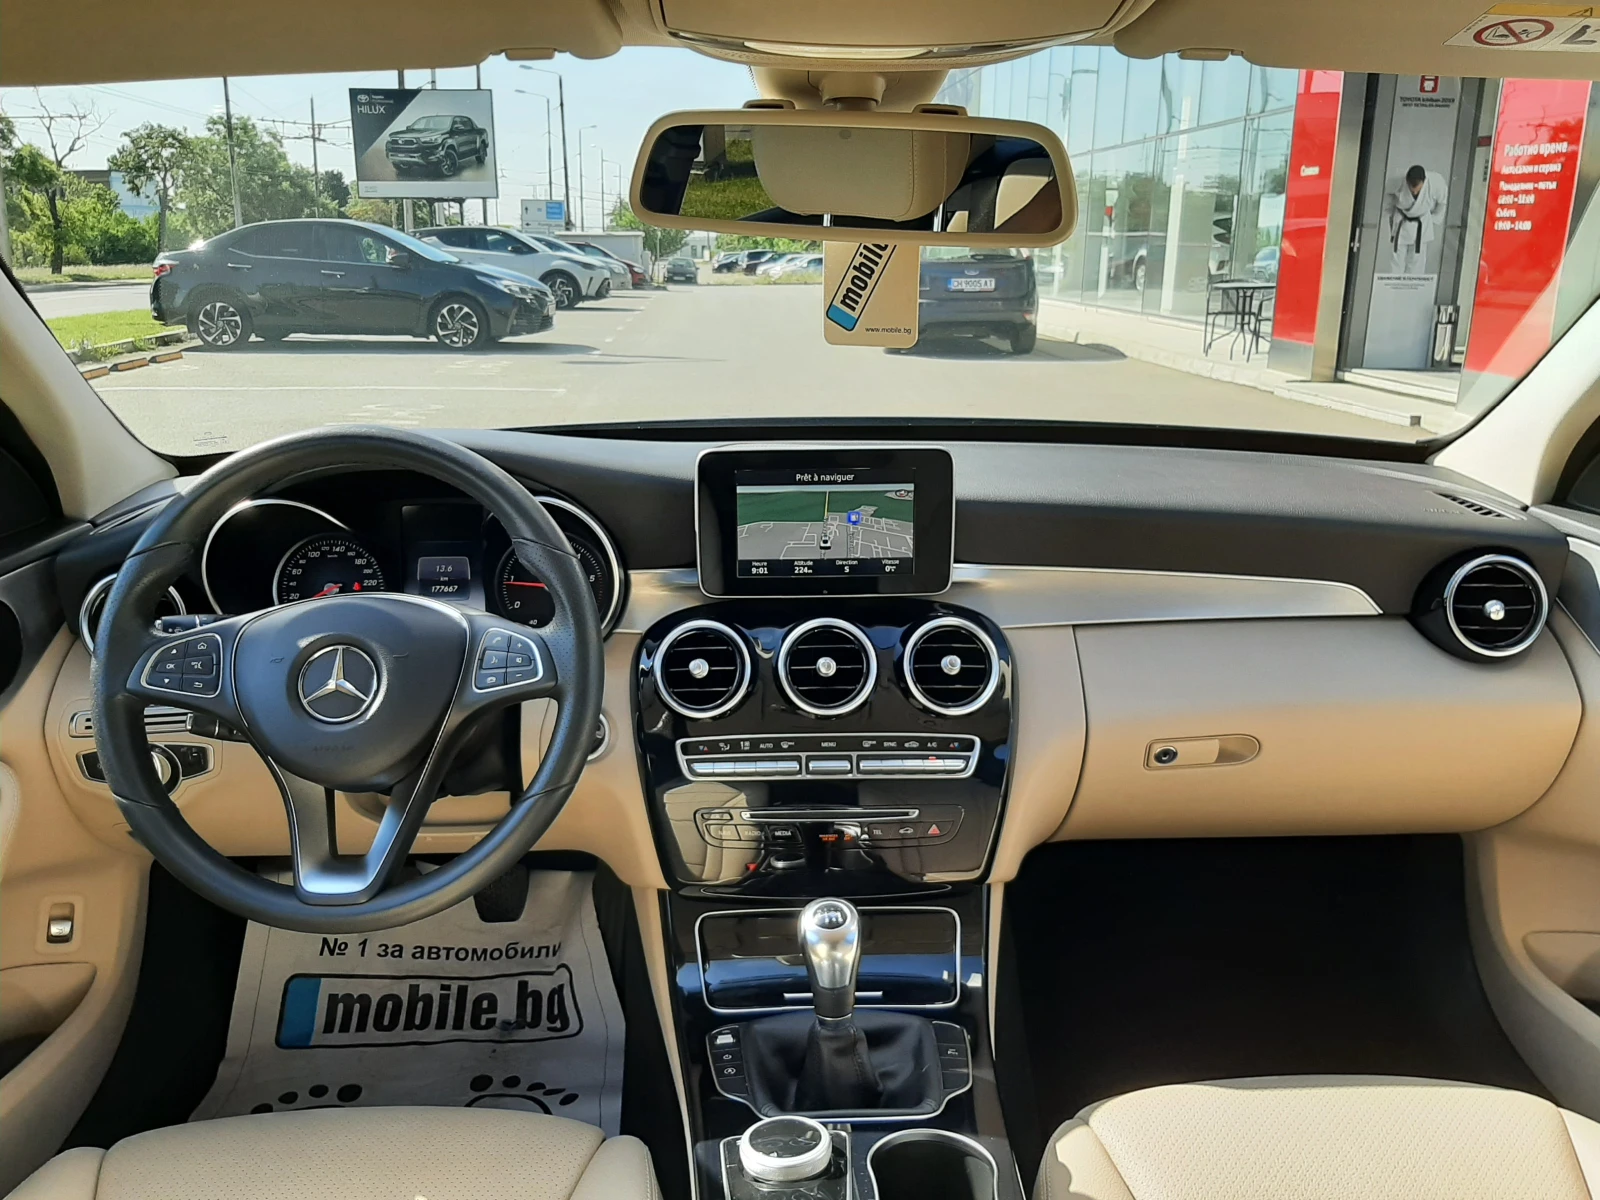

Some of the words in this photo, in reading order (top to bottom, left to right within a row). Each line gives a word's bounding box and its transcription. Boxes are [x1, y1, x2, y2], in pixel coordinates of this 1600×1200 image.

[357, 104, 386, 114] HILUX
[1504, 144, 1538, 156] Работно
[1540, 142, 1568, 157] време
[796, 473, 812, 481] Prêt
[814, 473, 818, 481] à
[820, 473, 854, 482] naviguer
[358, 938, 368, 958] 1
[377, 943, 404, 958] за
[412, 942, 562, 962] автомобили
